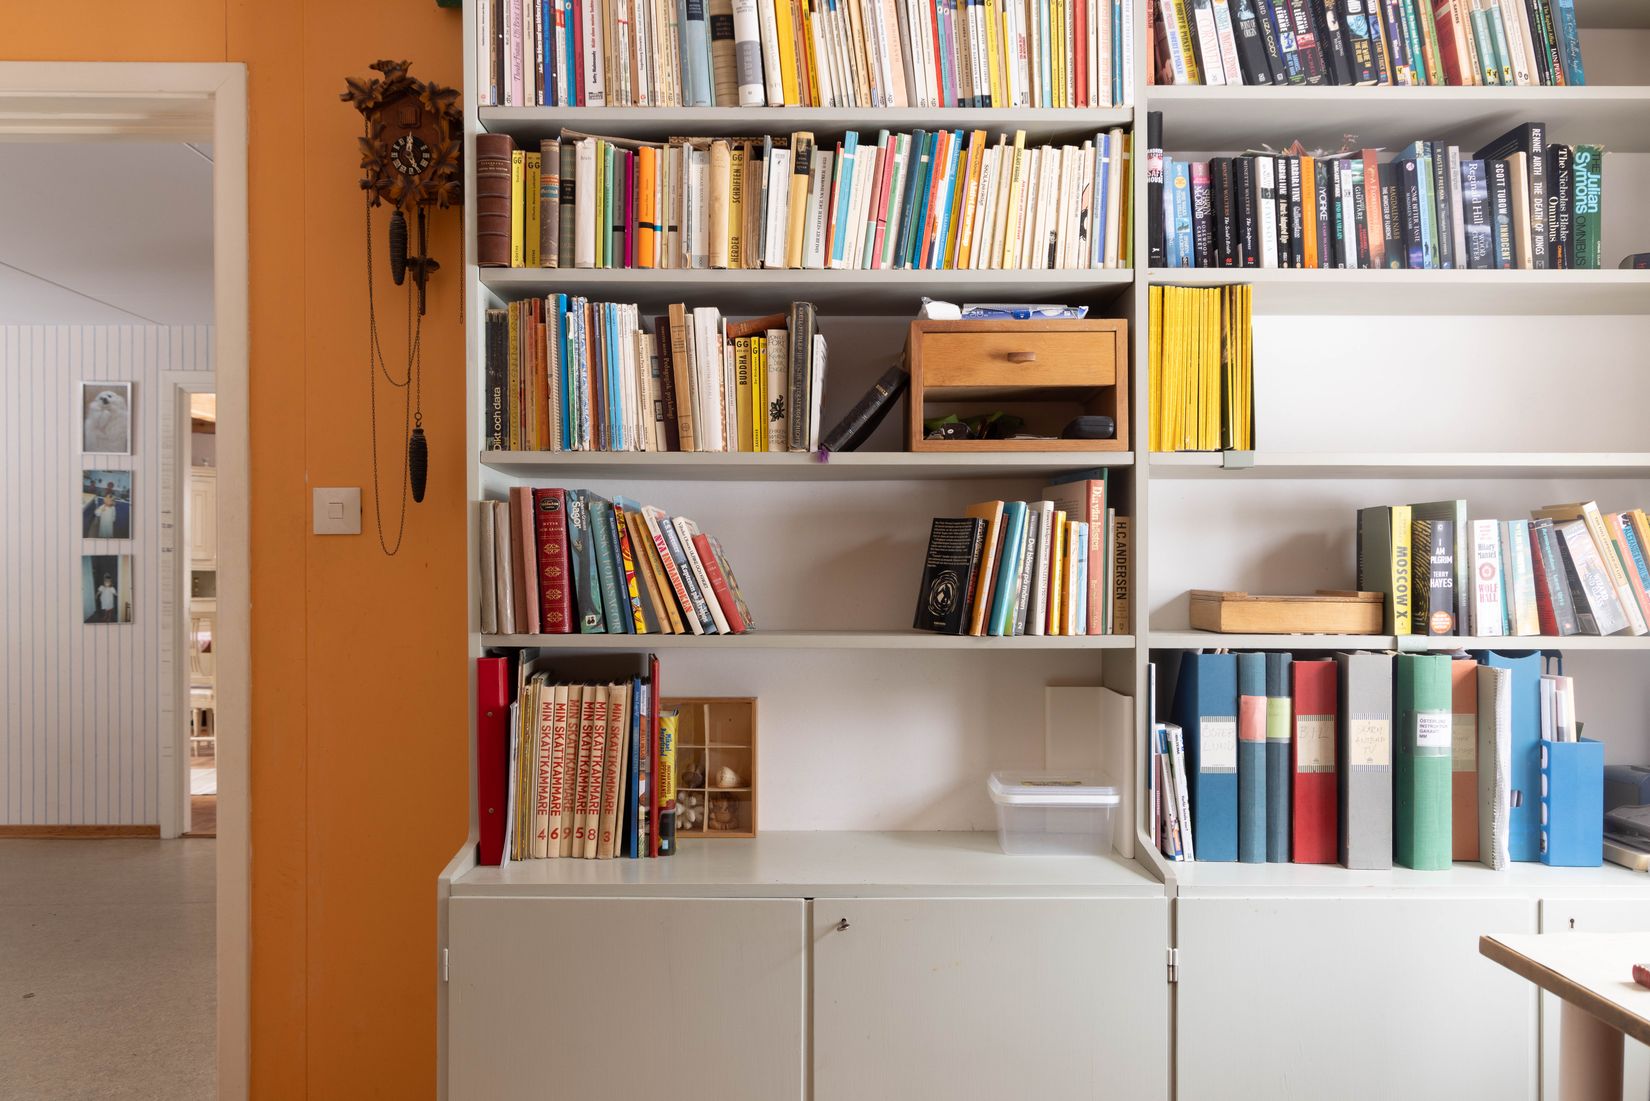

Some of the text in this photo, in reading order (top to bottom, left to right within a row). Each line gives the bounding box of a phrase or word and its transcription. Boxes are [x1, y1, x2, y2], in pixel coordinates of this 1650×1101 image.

[1262, 18, 1278, 58] LIZA CODY
[1275, 6, 1288, 32] LEHANE
[1294, 8, 1306, 34] LEHANE
[1181, 31, 1190, 52] PARKER
[1550, 48, 1558, 62] IAIN
[1278, 159, 1286, 183] BARBARA
[1291, 160, 1300, 202] BARBARA VINE
[1532, 128, 1544, 255] RENNIE AIRTH THE DEATH OF KINGS
[1573, 152, 1590, 214] Symons
[1588, 154, 1600, 213] THE Julian
[1203, 190, 1211, 215] SHARYN
[1319, 189, 1328, 221] YORKE
[1390, 186, 1398, 220] MAGDALEN
[1468, 164, 1483, 224] Reginald Hill
[1495, 164, 1510, 260] SCOTT TUROW INNOCENT
[1558, 148, 1568, 242] The Nicholas Blake
[731, 169, 741, 262] HERDER SCHRIFTEN
[1280, 203, 1288, 234] Dark-Adapted
[1548, 196, 1558, 242] Omnibus
[1478, 234, 1486, 256] WOOD
[1576, 216, 1586, 265] OMNIBUS
[663, 358, 673, 419] Pedagogisk psykologi
[739, 355, 748, 385] BUDDHA
[493, 388, 502, 451] Dikt och data
[571, 501, 582, 529] Sagor
[1092, 486, 1102, 550] Din vän hästen
[596, 501, 619, 630] SVENSKA FOLKSAGOR
[1026, 551, 1034, 572] blåser
[1116, 522, 1127, 600] H.C. ANDERSEN
[1431, 555, 1452, 564] PILGRIM
[1436, 547, 1445, 555] AM
[1541, 528, 1556, 570] Armageddon
[654, 534, 693, 613] NYA INDIANBOKEN
[681, 564, 696, 591] Kaptenen
[1024, 574, 1030, 584] på
[1396, 546, 1408, 619] MOSCOW X
[1430, 579, 1453, 588] HAYES
[1479, 584, 1498, 593] WOLF
[1020, 585, 1029, 609] månen
[1480, 594, 1498, 603] HALL
[659, 728, 667, 756] Bergstrand
[537, 702, 552, 840] MIN SKATTKAMMARE 4
[550, 703, 567, 839] MIN SKATTKAMMARE 6
[562, 700, 580, 840] MIN SKATTKAMMARE 9
[575, 701, 595, 839] MIN SKATTKAMMARE 5
[588, 702, 607, 840] MIN SKATTKAMMARE 8
[603, 703, 622, 842] MIN SKATTKAMMARE 3
